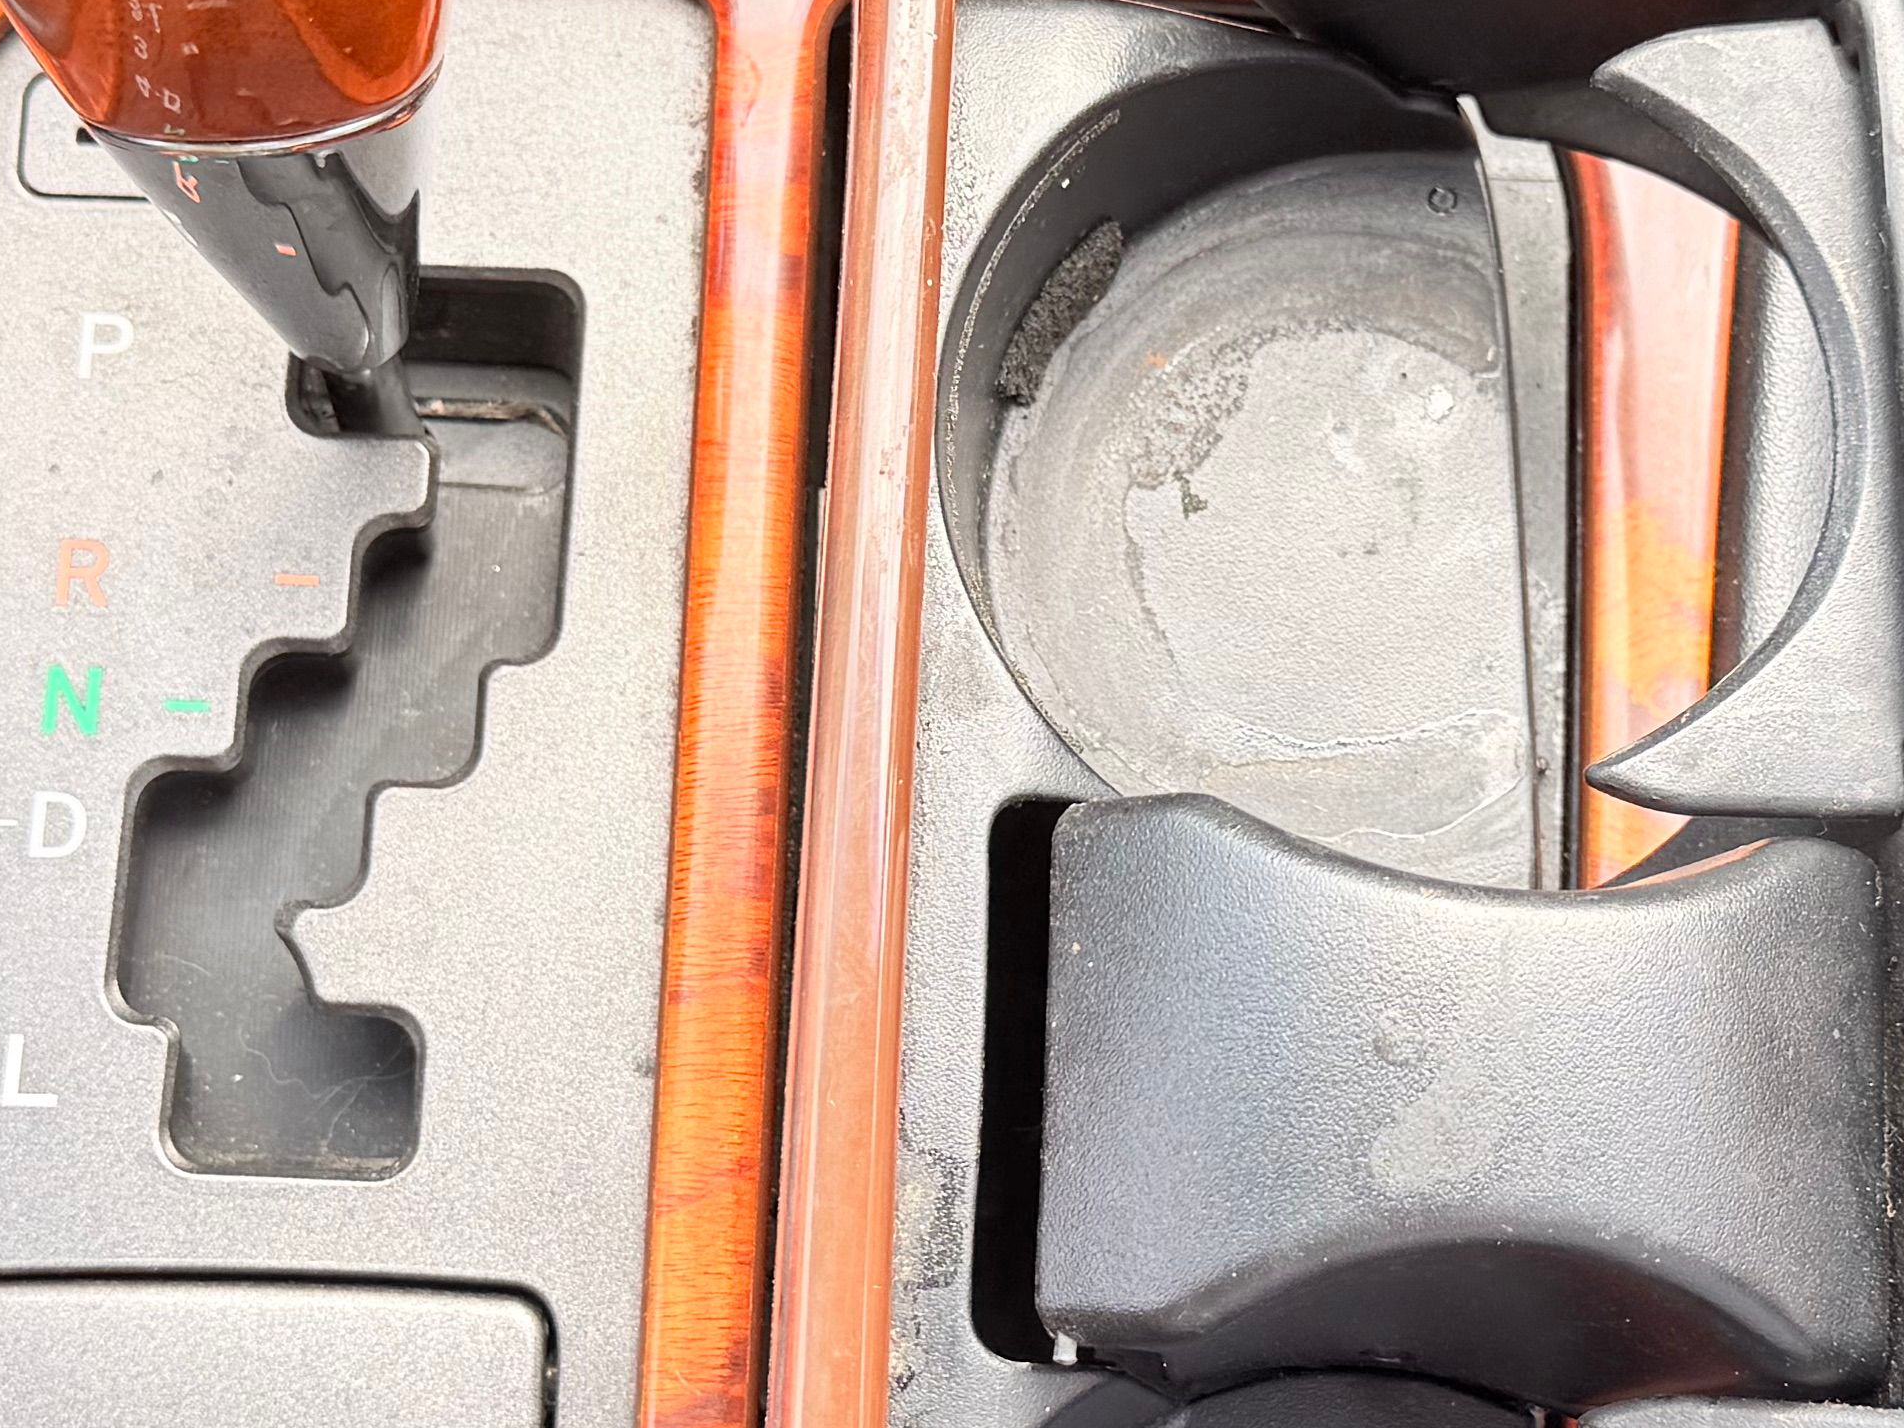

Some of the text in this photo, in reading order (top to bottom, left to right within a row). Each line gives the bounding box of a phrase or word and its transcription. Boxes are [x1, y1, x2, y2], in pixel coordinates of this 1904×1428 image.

[77, 312, 135, 376] P
[52, 537, 110, 608] R
[39, 663, 105, 736] N
